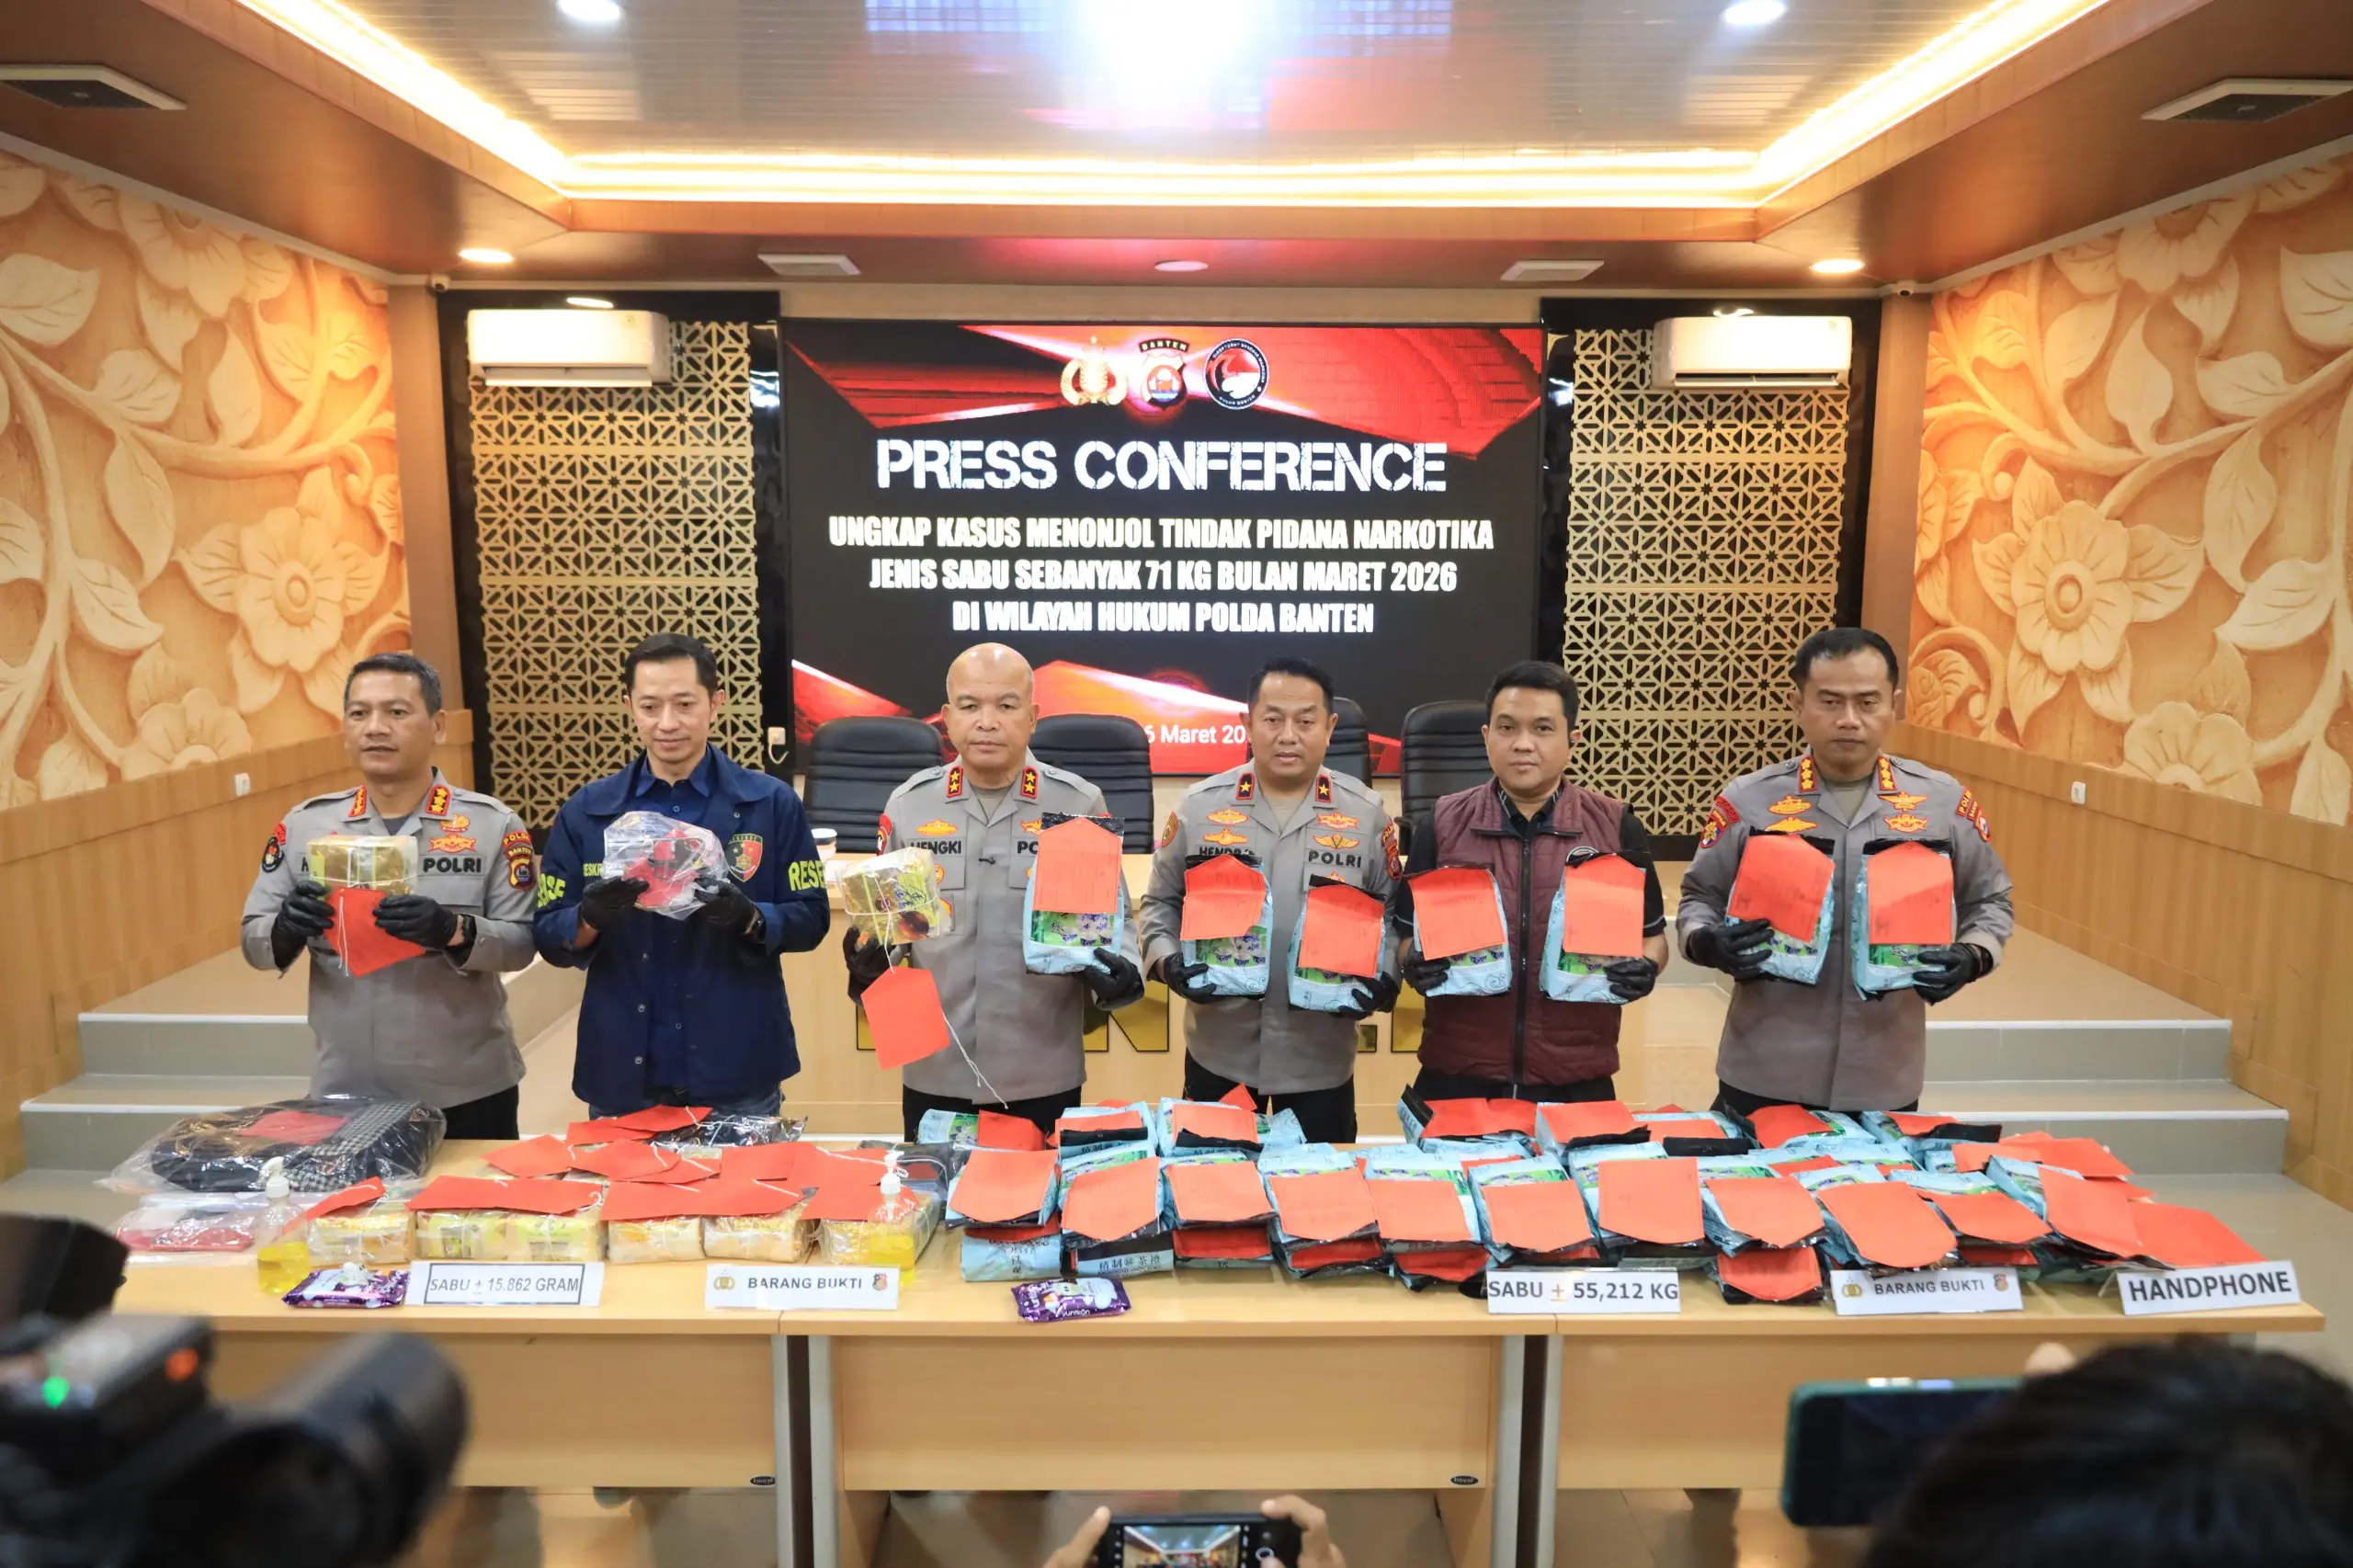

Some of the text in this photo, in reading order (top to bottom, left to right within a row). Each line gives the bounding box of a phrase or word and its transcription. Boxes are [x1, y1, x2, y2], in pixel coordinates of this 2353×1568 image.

[1141, 340, 1188, 351] BANTEN
[877, 439, 1447, 491] PRESS CONFERENCE
[829, 516, 1494, 550] UNGKAP KASUS MENONJOL TINDAK PIDANA NARKOTIKA
[870, 559, 1458, 592] JENIS SABU SEBANYAK 71 KG BULAN MARET 2026
[952, 601, 1374, 632] DI WILAYAH HUKUM POLDA BANTEN
[1161, 725, 1217, 744] Maret
[1222, 725, 1247, 744] 20
[423, 858, 482, 873] POLRI
[1308, 849, 1361, 868] POLRI
[430, 1278, 470, 1291] SABU
[488, 1278, 531, 1291] 15.862
[536, 1278, 578, 1291] GRAM
[748, 1278, 862, 1289] BARANG BUKTI
[1488, 1281, 1543, 1297] SABU
[1574, 1282, 1643, 1301] 55,212
[1651, 1283, 1678, 1299] KG
[1875, 1278, 1985, 1295] BARANG BUKTI
[2128, 1271, 2291, 1301] HANDPHONE
